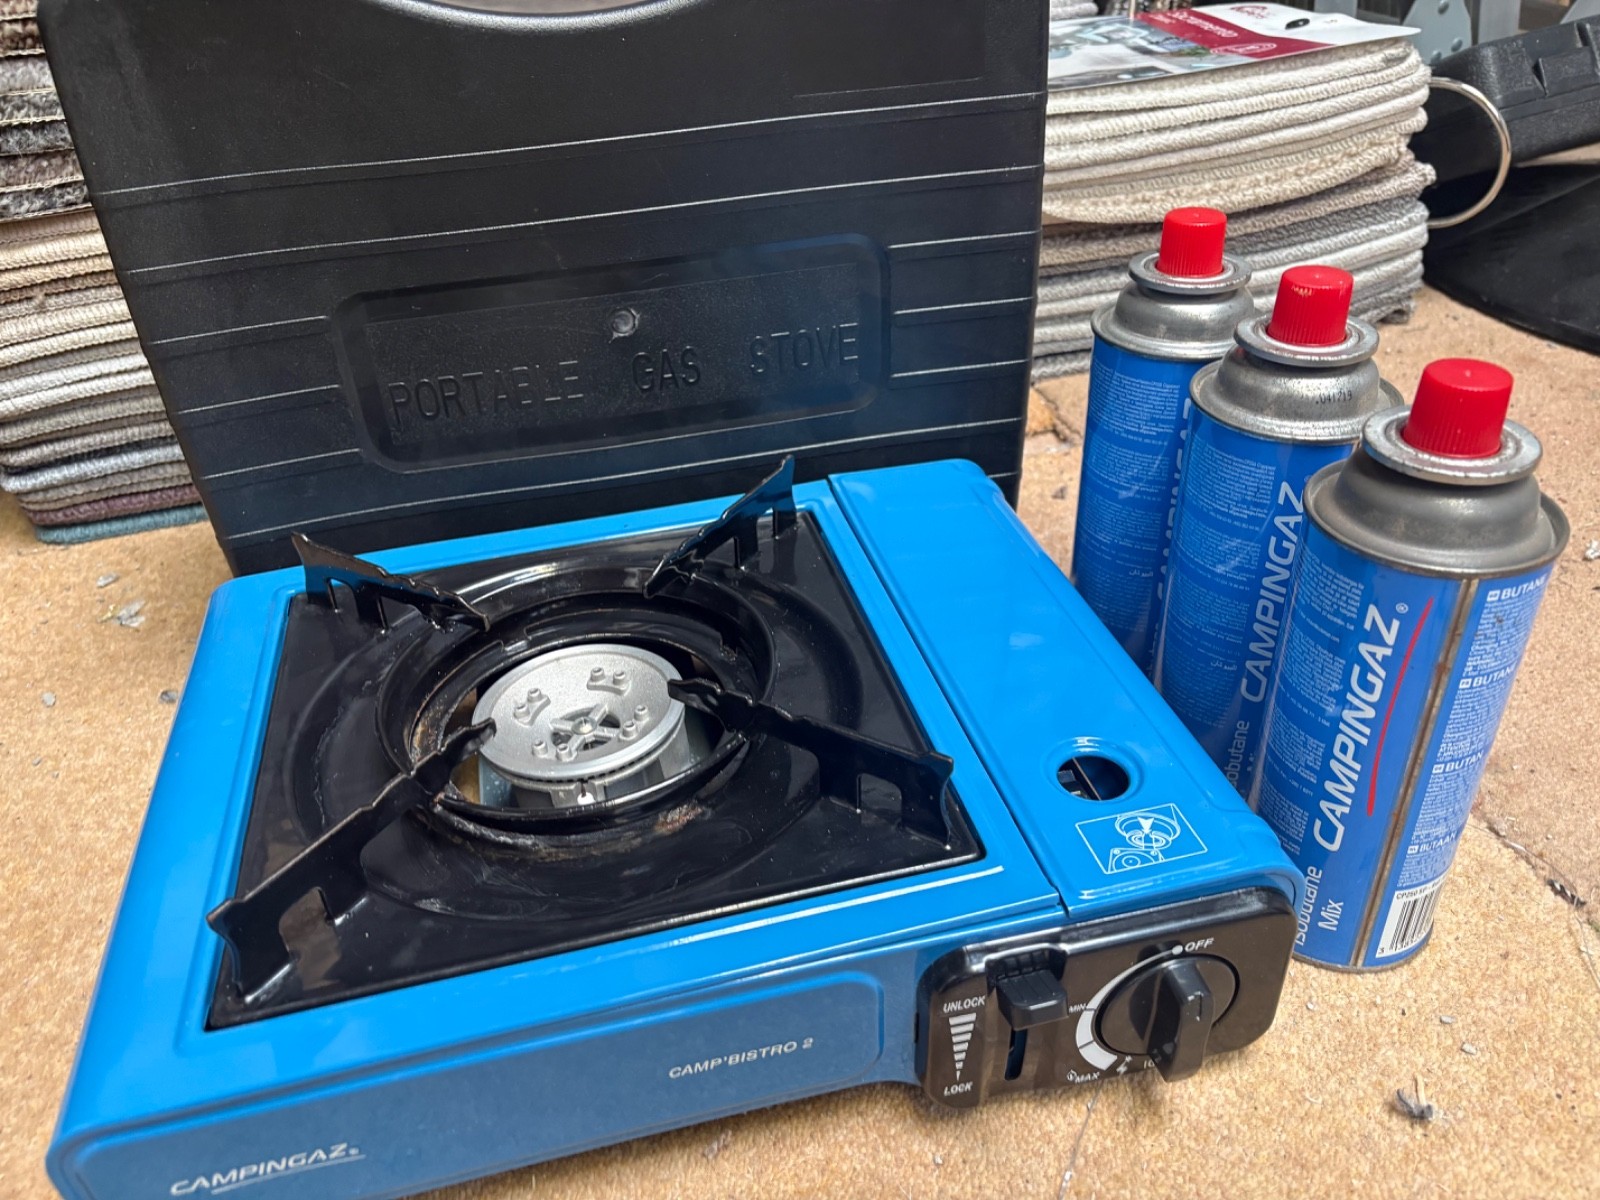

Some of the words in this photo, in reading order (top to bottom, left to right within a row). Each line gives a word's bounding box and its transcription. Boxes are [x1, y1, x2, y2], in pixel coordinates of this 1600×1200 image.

[631, 345, 701, 395] GAS
[749, 322, 859, 375] STOVE
[1240, 480, 1304, 703] CAMPINGAZ
[1317, 898, 1345, 932] Mix
[1184, 936, 1215, 953] OFF
[942, 995, 986, 1014] UNLOCK
[1068, 1003, 1087, 1013] MIN
[668, 1040, 798, 1079] CAMP'BISTRO
[801, 1036, 814, 1050] 2
[1075, 1071, 1101, 1084] MAX
[943, 1081, 974, 1097] LOCK
